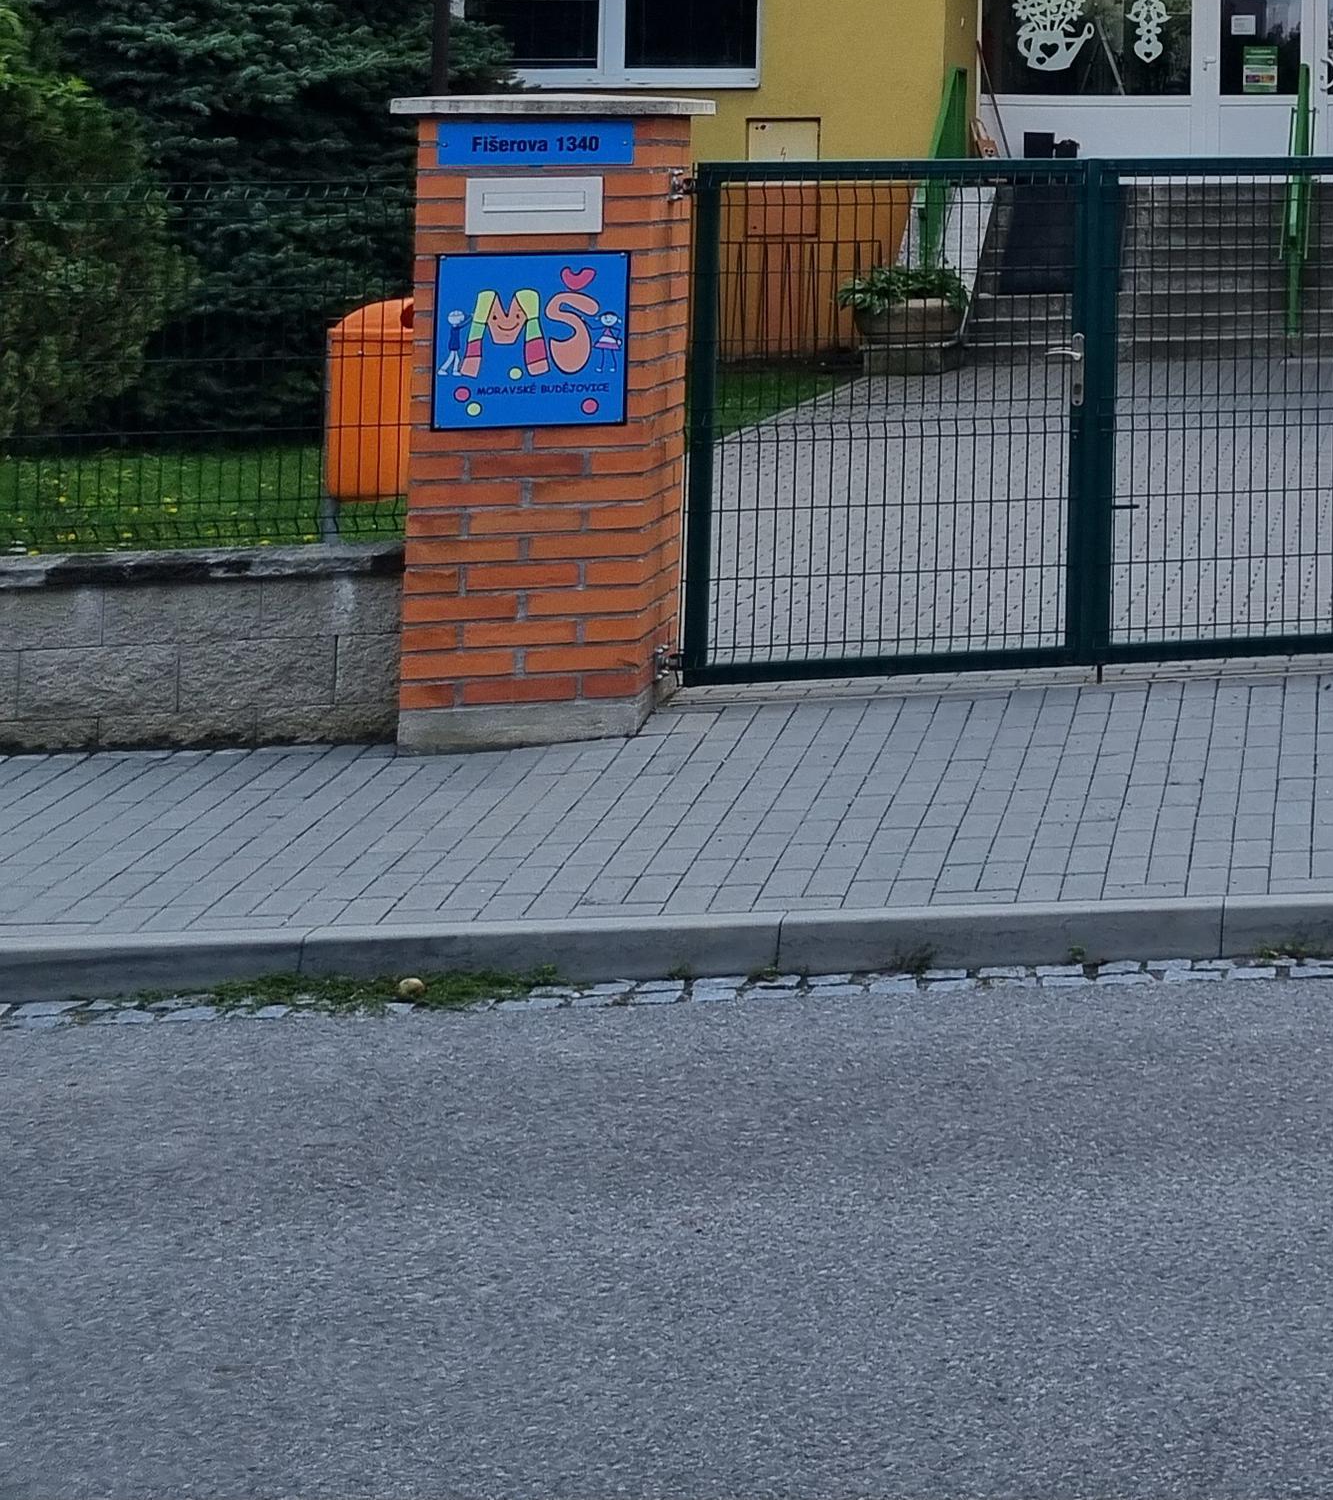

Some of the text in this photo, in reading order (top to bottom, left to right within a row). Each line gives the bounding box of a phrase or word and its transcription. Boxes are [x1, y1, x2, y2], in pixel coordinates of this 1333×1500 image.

[472, 136, 599, 152] Fišerova 1340
[460, 266, 600, 378] MŠ
[476, 382, 609, 396] MORAVSKÉ BUDĚJOVICE
